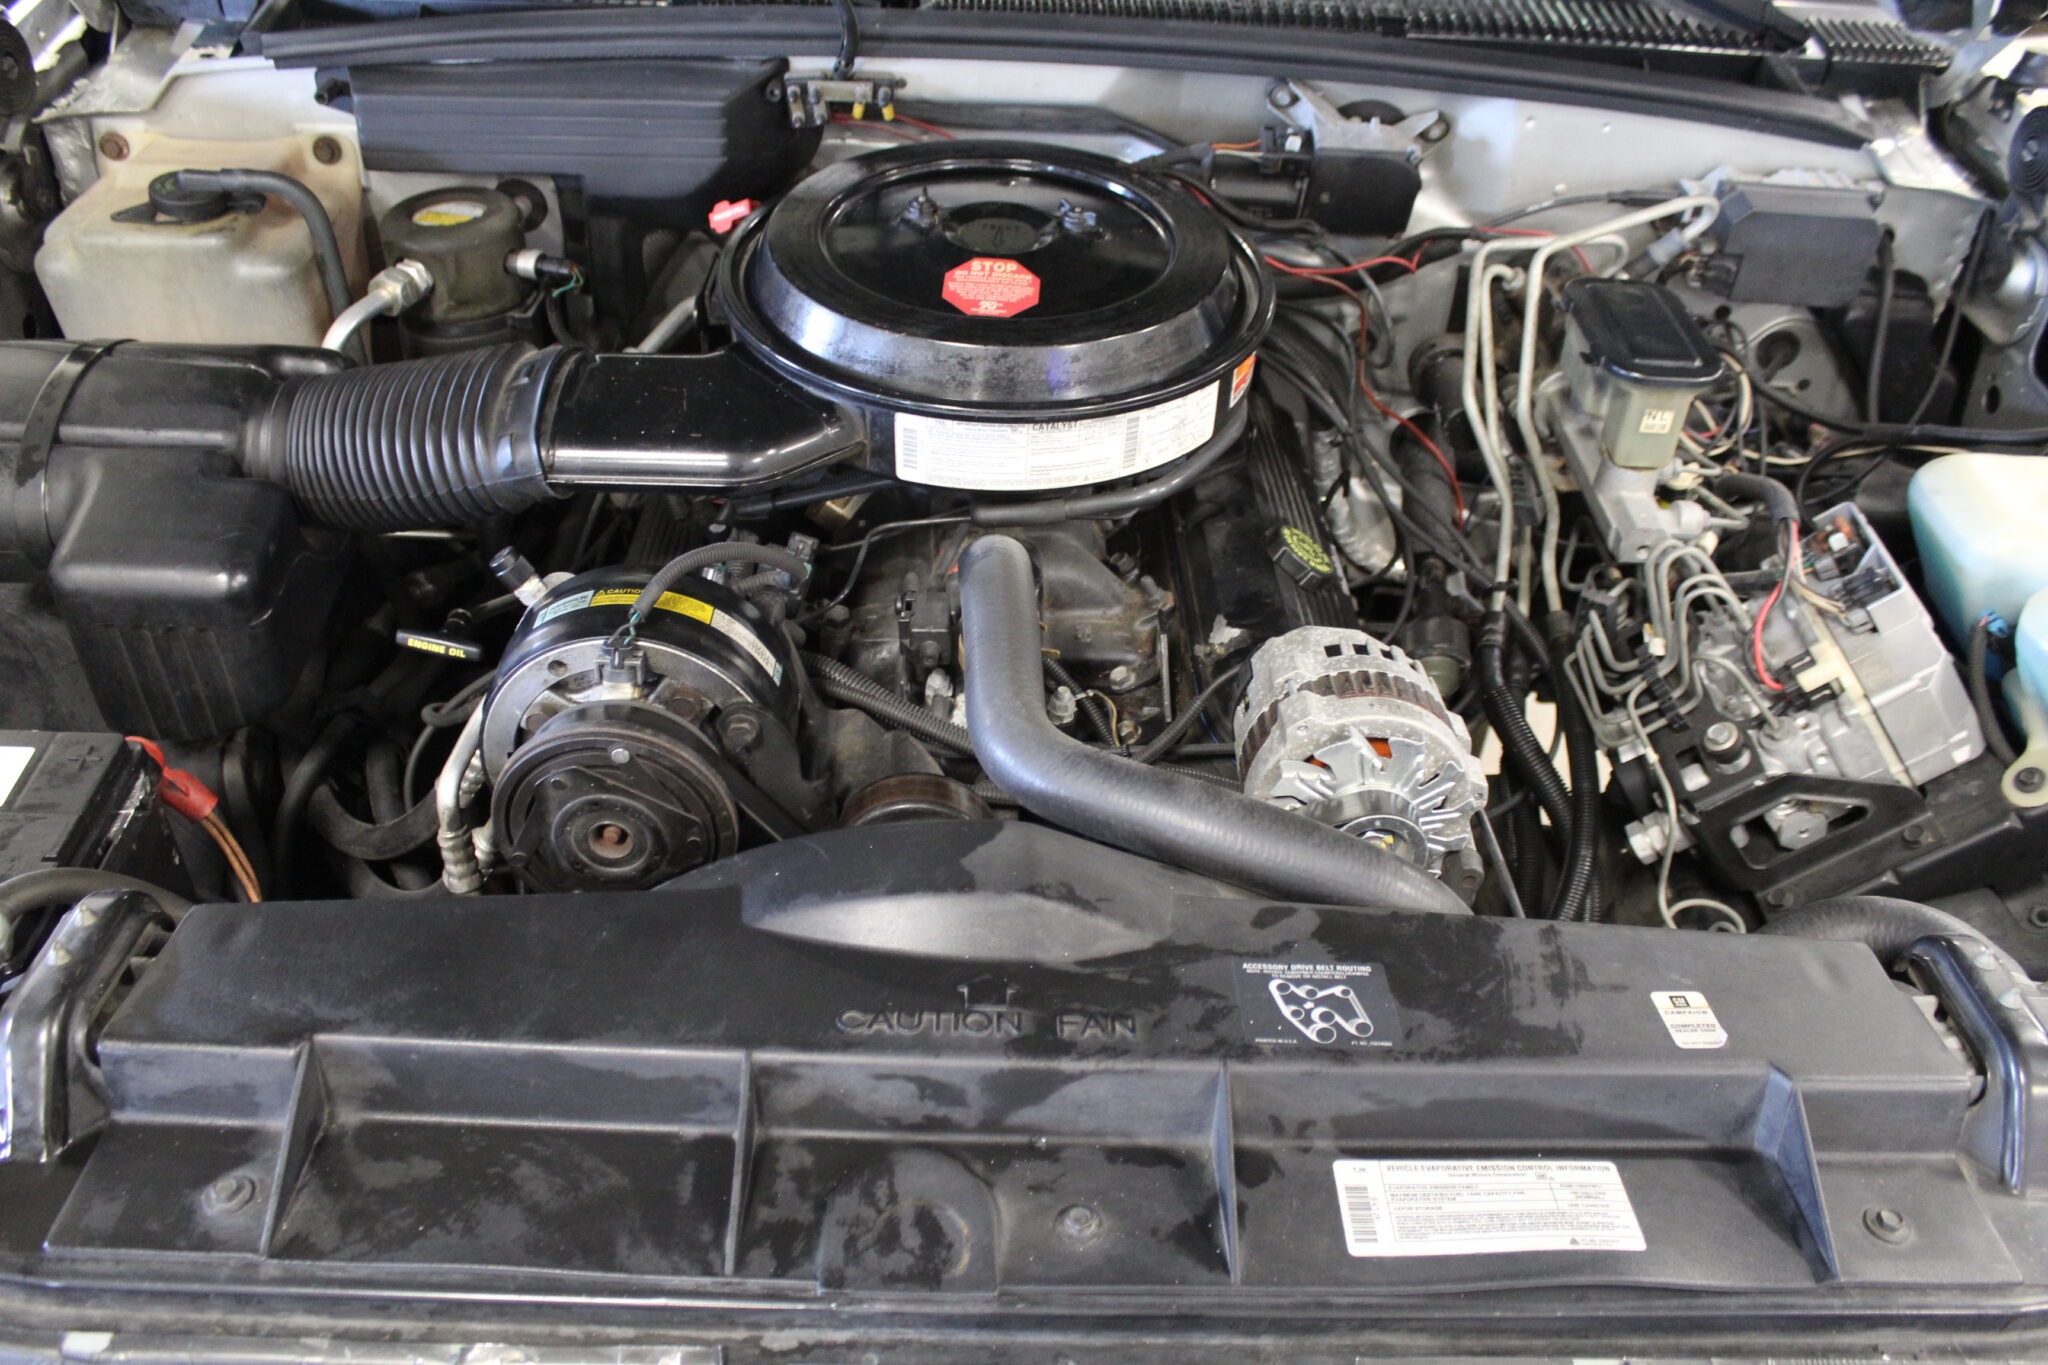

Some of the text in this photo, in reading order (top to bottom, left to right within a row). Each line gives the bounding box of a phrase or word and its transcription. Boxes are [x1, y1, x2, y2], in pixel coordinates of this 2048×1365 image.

[971, 260, 1018, 272] STOP
[407, 638, 466, 658] ENGINE OIL
[1242, 962, 1289, 971] ACCESSORY
[1336, 965, 1372, 973] ROUTING
[836, 1008, 1137, 1039] CAUTION FAN
[1386, 1164, 1611, 1172] VEHICLE EVAPORATIVE EMISSION CONTROL INFORMATION
